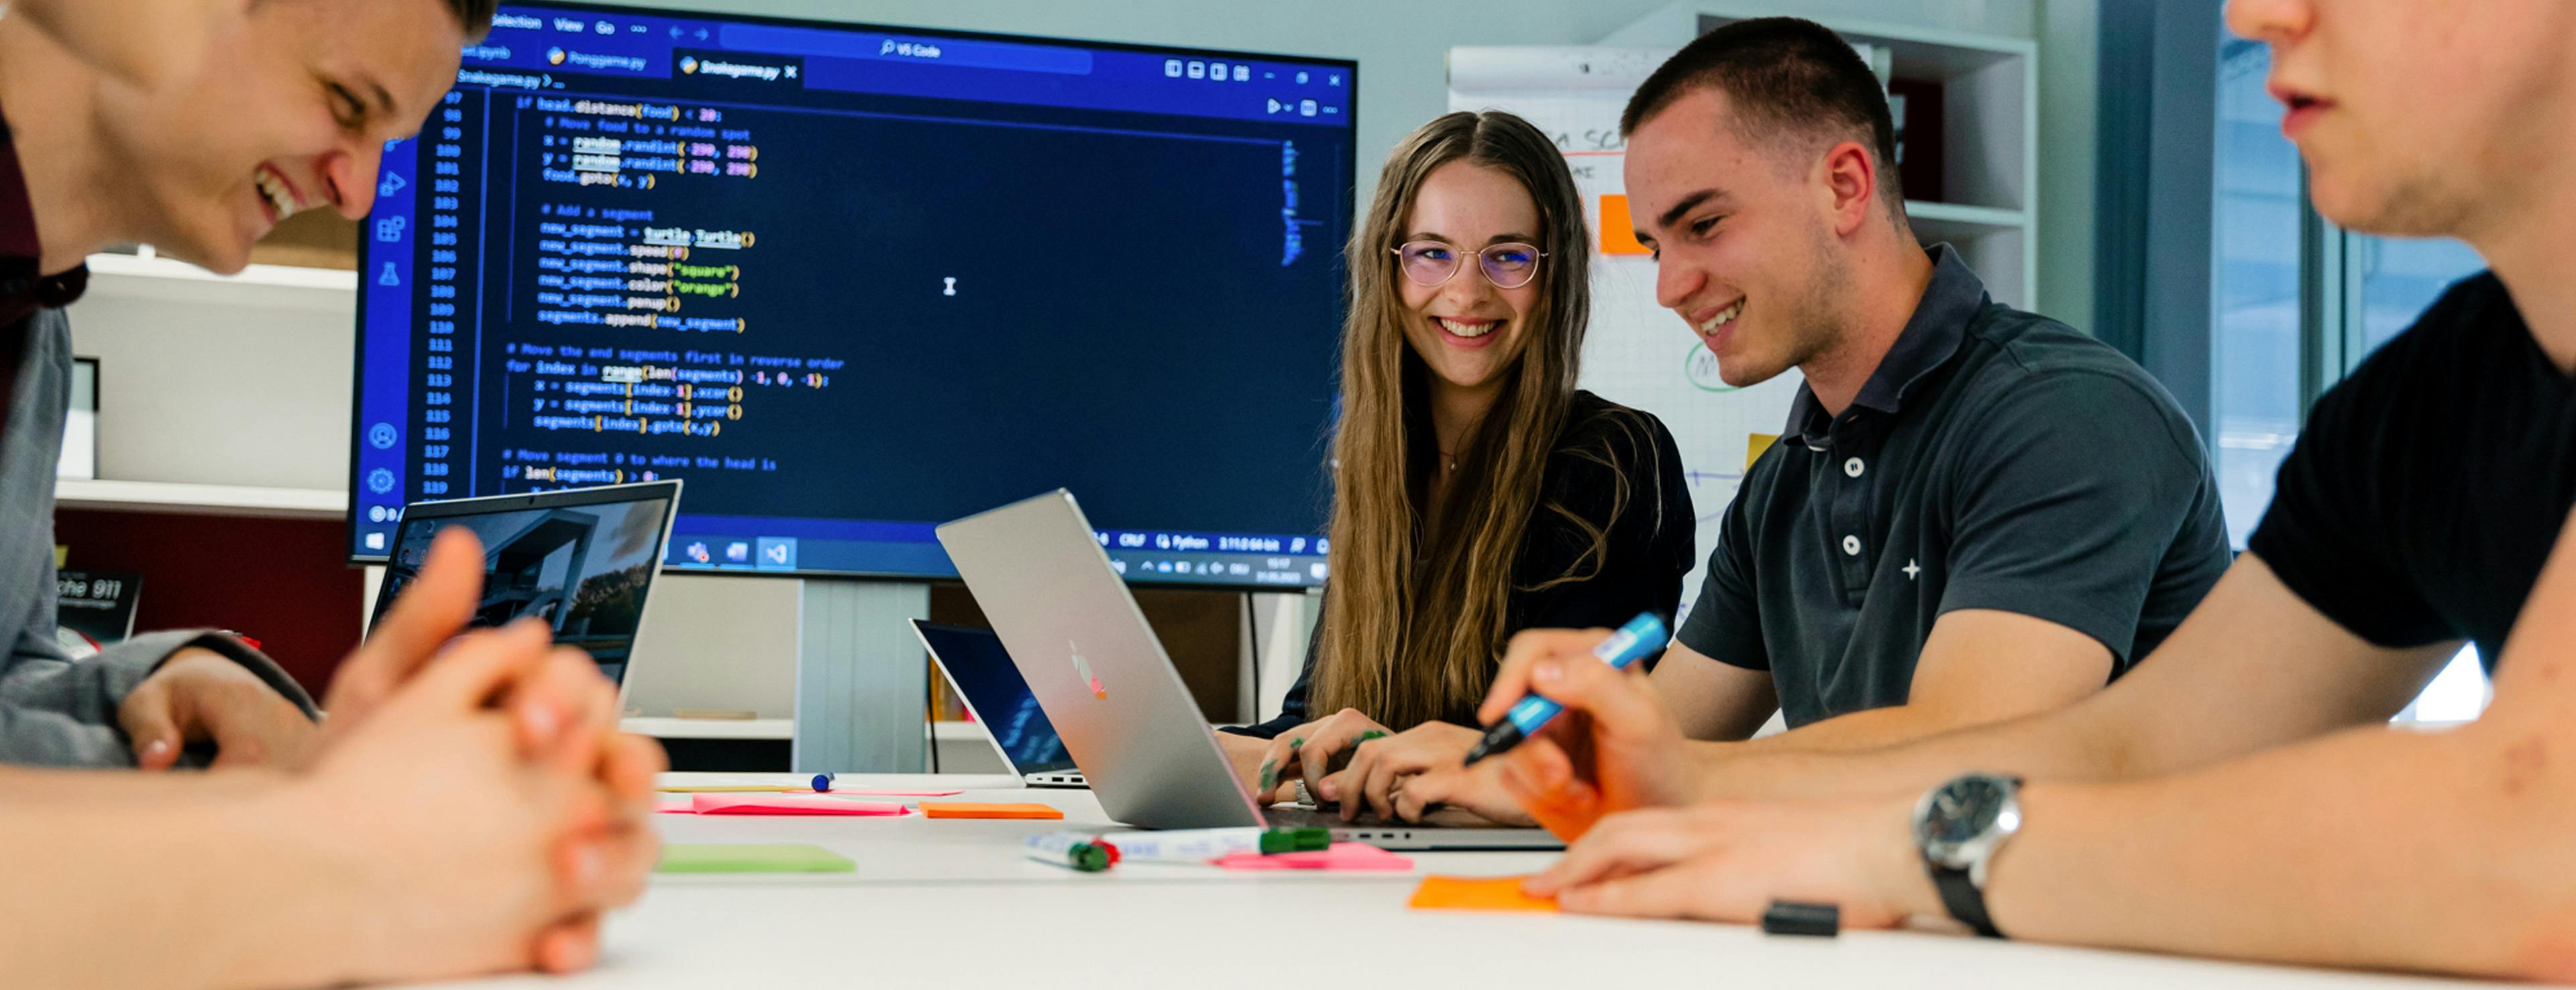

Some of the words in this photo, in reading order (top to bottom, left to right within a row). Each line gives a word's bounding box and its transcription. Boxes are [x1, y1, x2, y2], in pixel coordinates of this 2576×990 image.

[491, 13, 542, 30] Selection
[553, 17, 584, 32] View
[595, 20, 615, 34] Go
[897, 42, 912, 56] VS
[913, 44, 941, 58] Code
[568, 51, 647, 71] Ponggame.py
[700, 60, 780, 81] Snakegame.py
[457, 69, 541, 90] Snakegame.py
[444, 91, 462, 105] 97
[443, 108, 462, 122] 98
[516, 96, 533, 109] if
[537, 97, 680, 121] head.distance(food)
[443, 126, 462, 140] 99
[559, 117, 591, 130] Move
[597, 118, 628, 132] food
[633, 122, 649, 134] to
[654, 125, 664, 134] a
[669, 125, 716, 138] random
[720, 128, 751, 141] spot
[543, 135, 554, 146] x
[436, 144, 461, 157] 100
[542, 152, 553, 166] y
[435, 161, 460, 175] 101
[435, 179, 459, 192] 102
[434, 196, 458, 210] 103
[433, 214, 458, 227] 104
[556, 205, 580, 217] Add
[586, 207, 595, 217] a
[602, 209, 654, 222] segment
[433, 232, 457, 245] 105
[539, 222, 625, 239] new_segment
[643, 227, 755, 250] turtle.Turtle()
[431, 249, 457, 263] 106
[539, 239, 690, 261] new_segment.speed(0)
[431, 267, 456, 280] 107
[431, 284, 455, 298] 108
[430, 303, 455, 316] 109
[537, 292, 681, 313] new_segment.penup()
[429, 321, 454, 334] 110
[537, 310, 745, 333] segments.append(new_segment)
[429, 338, 453, 352] 111
[427, 355, 453, 370] 112
[521, 343, 553, 356] Move
[559, 345, 583, 357] the
[588, 347, 613, 358] end
[619, 349, 678, 363] segments
[685, 350, 722, 364] first
[729, 351, 745, 366] in
[749, 355, 802, 368] reverse
[806, 356, 845, 370] order
[506, 359, 531, 372] for
[536, 360, 576, 375] index
[581, 362, 598, 376] in
[427, 374, 452, 387] 113
[426, 391, 451, 405] 114
[535, 380, 545, 392] x
[565, 381, 743, 402] segments[index-1].xcor()
[425, 409, 450, 423] 115
[533, 398, 545, 412] y
[564, 398, 743, 421] segments[index-1].ycor()
[533, 415, 720, 437] segments[index].goto(x,y)
[425, 427, 450, 441] 116
[424, 445, 449, 458] 117
[517, 449, 549, 461] Move
[555, 452, 608, 465] segment
[629, 453, 646, 465] to
[651, 455, 690, 468] where
[696, 456, 718, 468] the
[724, 456, 755, 470] head
[762, 457, 776, 471] is
[423, 462, 449, 476] 118
[502, 465, 519, 479] if
[525, 465, 623, 484] len(segments)
[423, 481, 448, 494] 119
[1172, 535, 1209, 551] Python
[57, 580, 87, 598] che
[93, 579, 122, 599] 911
